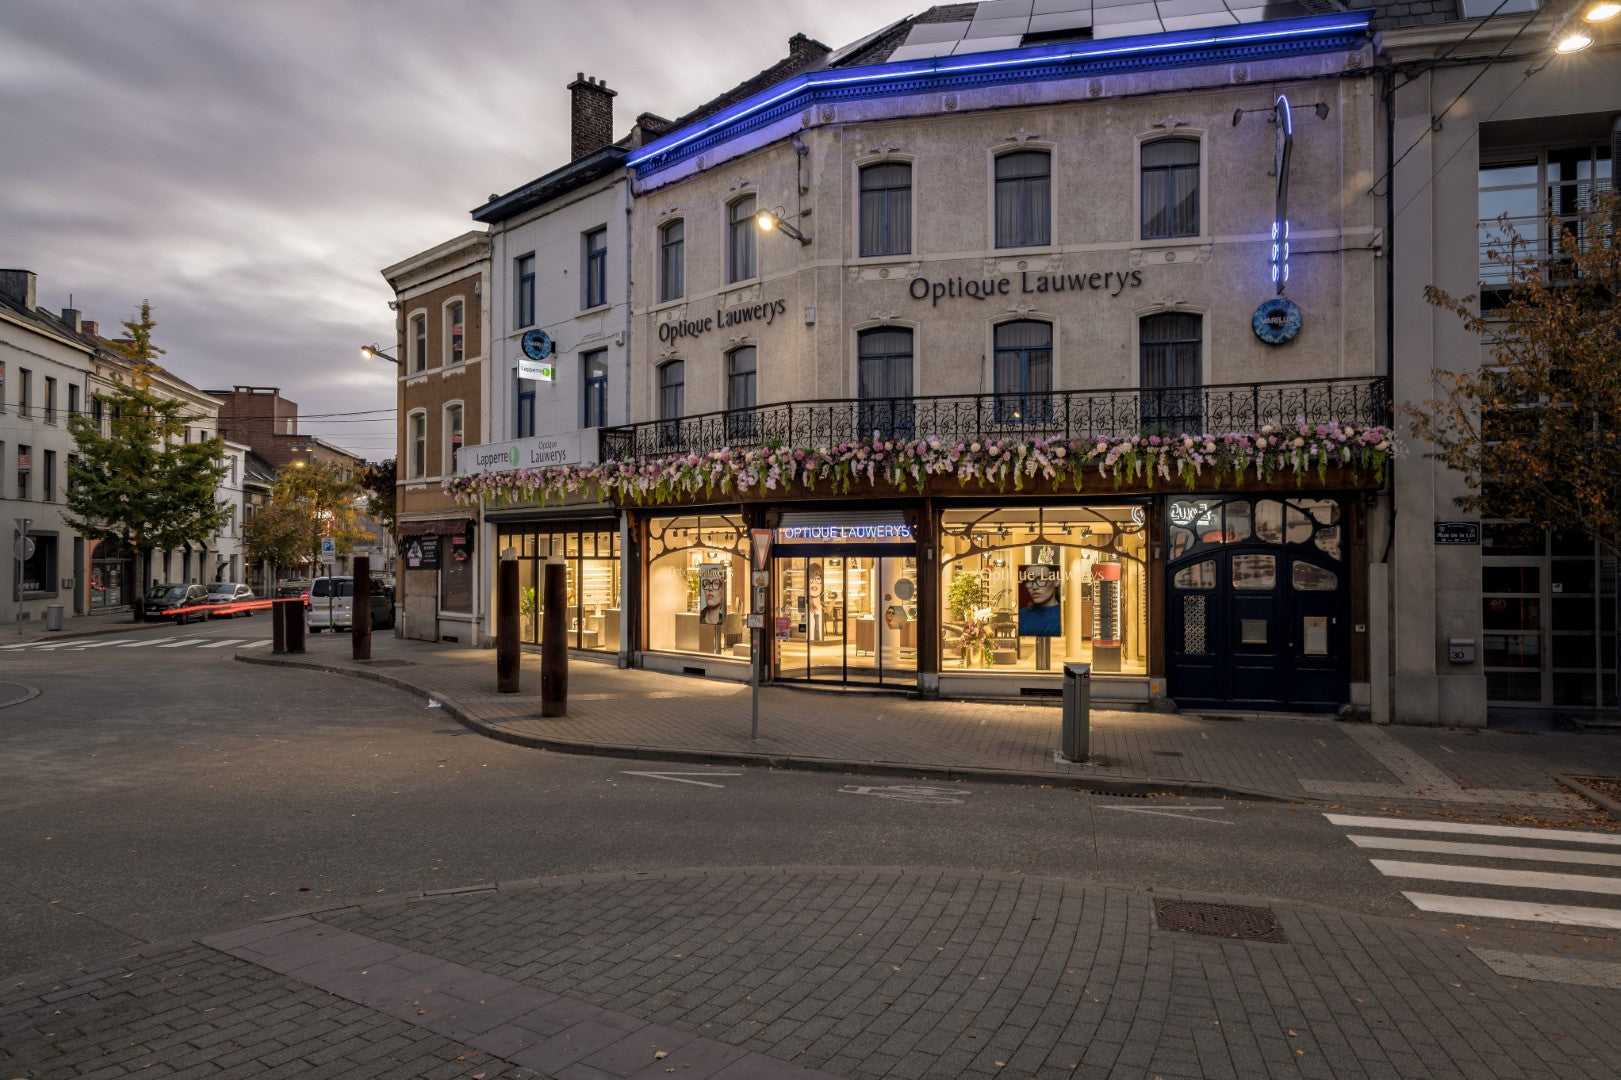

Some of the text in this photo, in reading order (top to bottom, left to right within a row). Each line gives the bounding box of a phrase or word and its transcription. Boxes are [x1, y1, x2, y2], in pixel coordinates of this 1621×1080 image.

[909, 269, 1143, 307] Optique Lauwerys
[658, 299, 786, 345] Optique Lauwerys
[538, 440, 557, 449] Optique
[476, 451, 508, 467] Lapperre
[530, 448, 566, 464] Lauwerys
[784, 525, 910, 539] OPTIQUE LAUWERYS
[1452, 651, 1464, 660] 30
